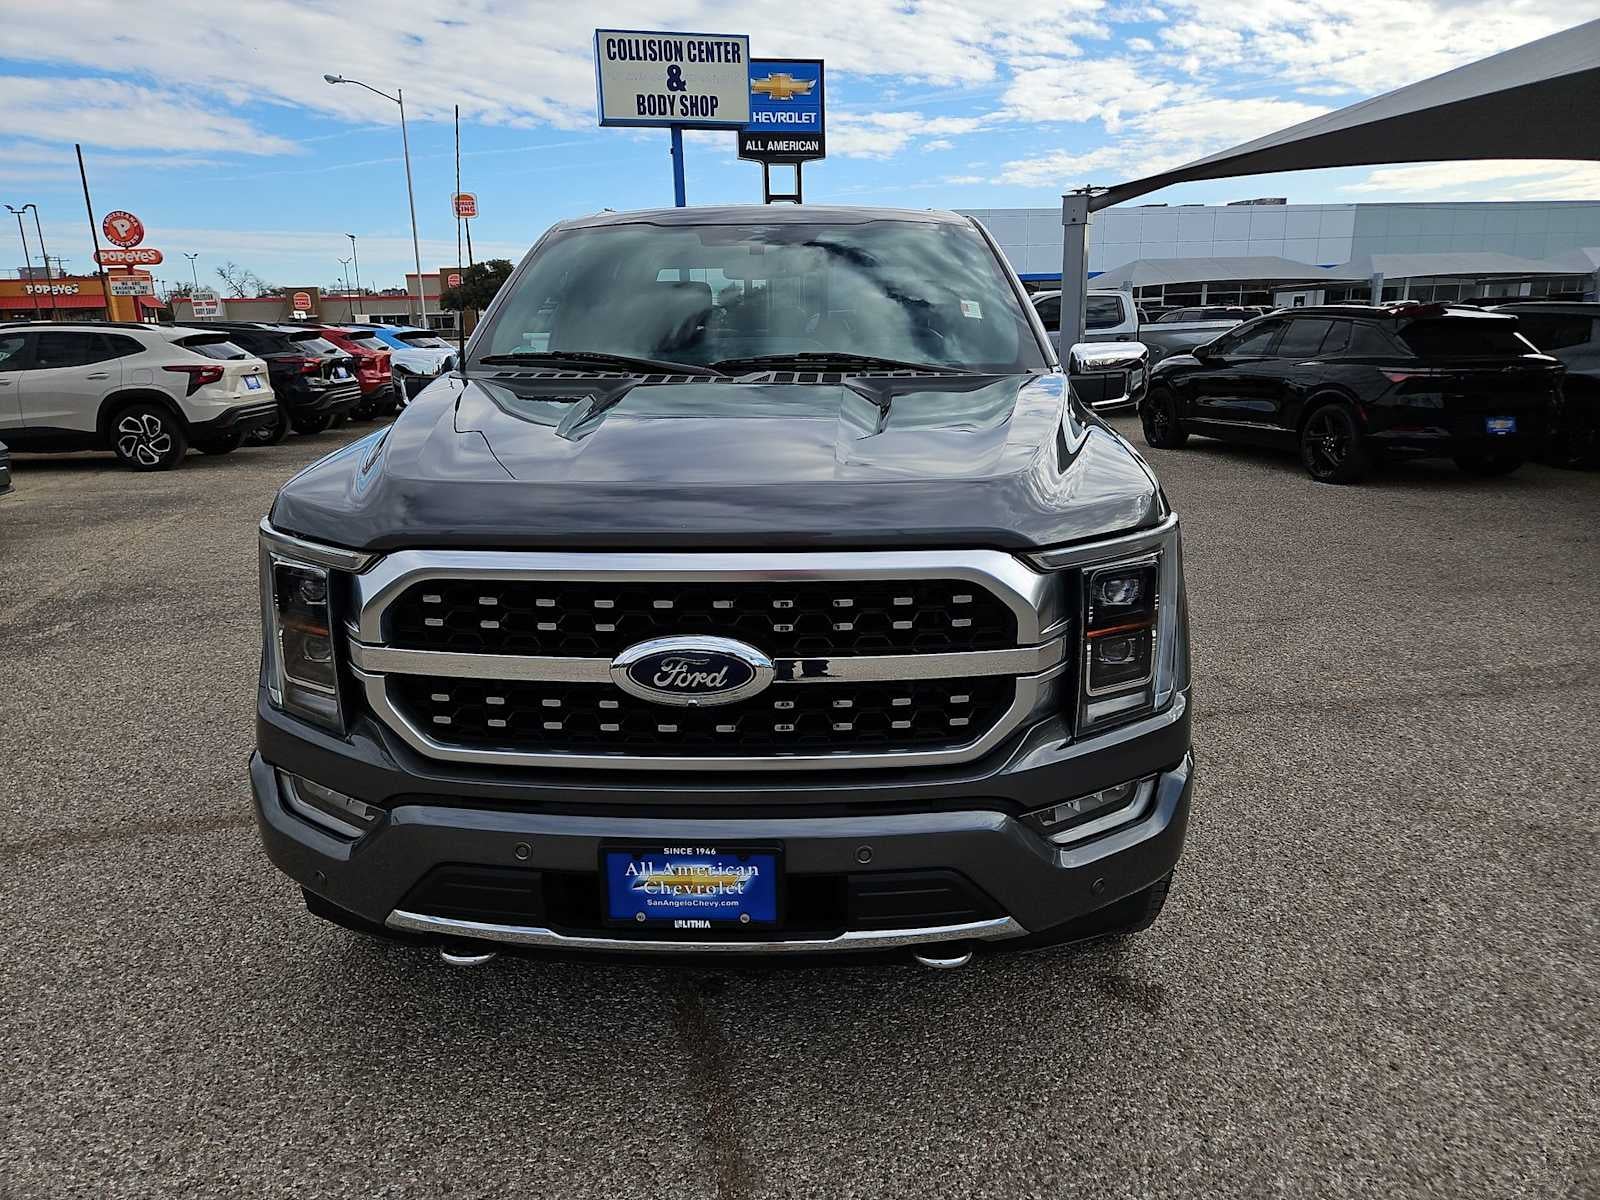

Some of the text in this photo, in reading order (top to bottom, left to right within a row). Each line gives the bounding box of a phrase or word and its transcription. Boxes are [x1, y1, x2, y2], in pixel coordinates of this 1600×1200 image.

[606, 38, 742, 63] COLLISION CENTER
[666, 64, 687, 92] &
[636, 94, 719, 117] BODY SHOP
[752, 111, 817, 124] HEVROLET
[745, 140, 819, 151] ALL AMERICAN
[103, 212, 138, 227] LOUISIANA
[99, 250, 156, 263] POPEYES
[25, 283, 80, 295] POPEYES
[653, 656, 729, 687] Ford
[663, 847, 717, 856] SINCE 1946
[625, 861, 760, 877] All American
[643, 880, 745, 896] Chevrolet
[646, 899, 740, 908] SanAngeloChevy.com
